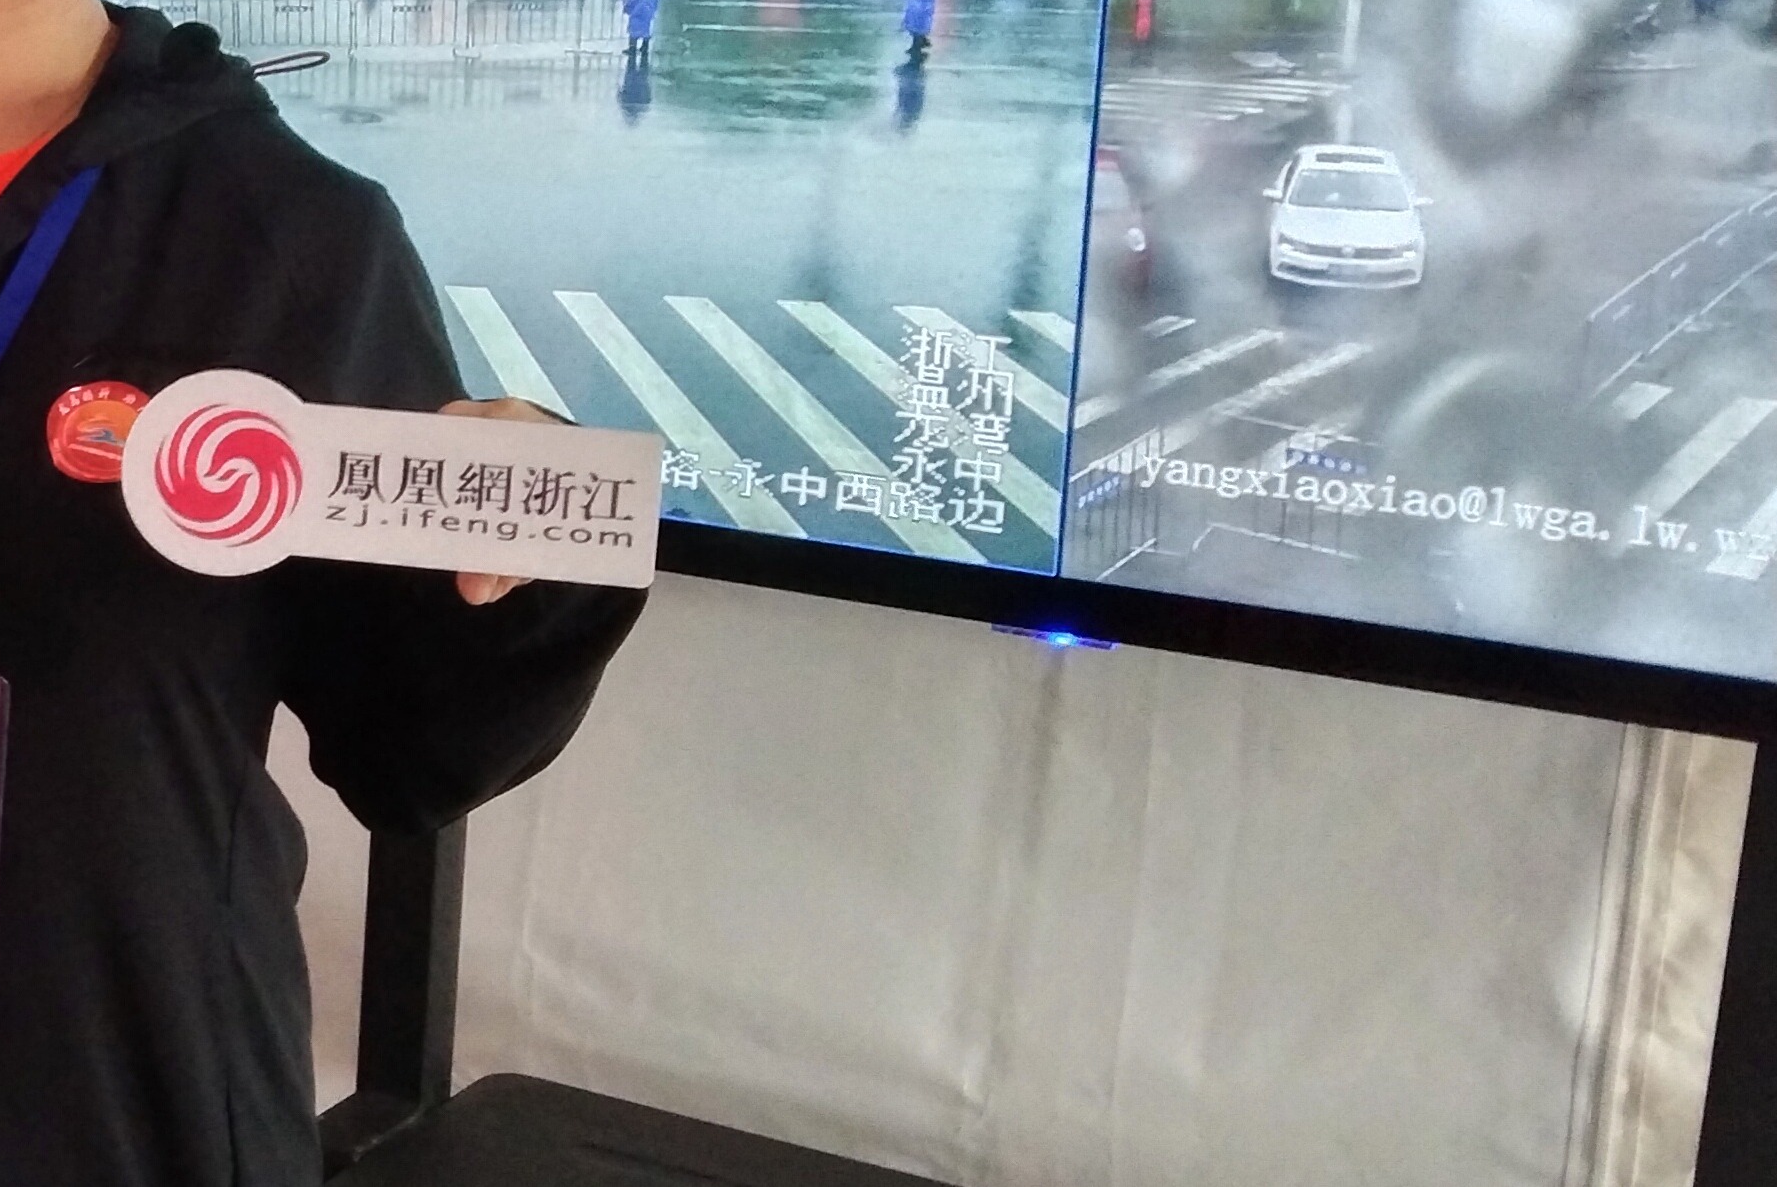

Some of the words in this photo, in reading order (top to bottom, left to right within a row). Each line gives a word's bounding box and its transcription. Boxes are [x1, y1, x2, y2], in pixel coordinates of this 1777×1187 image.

[327, 450, 637, 522] 鳳凰網浙江
[891, 445, 1003, 492] 永中
[325, 504, 634, 548] zj.ifeng.com
